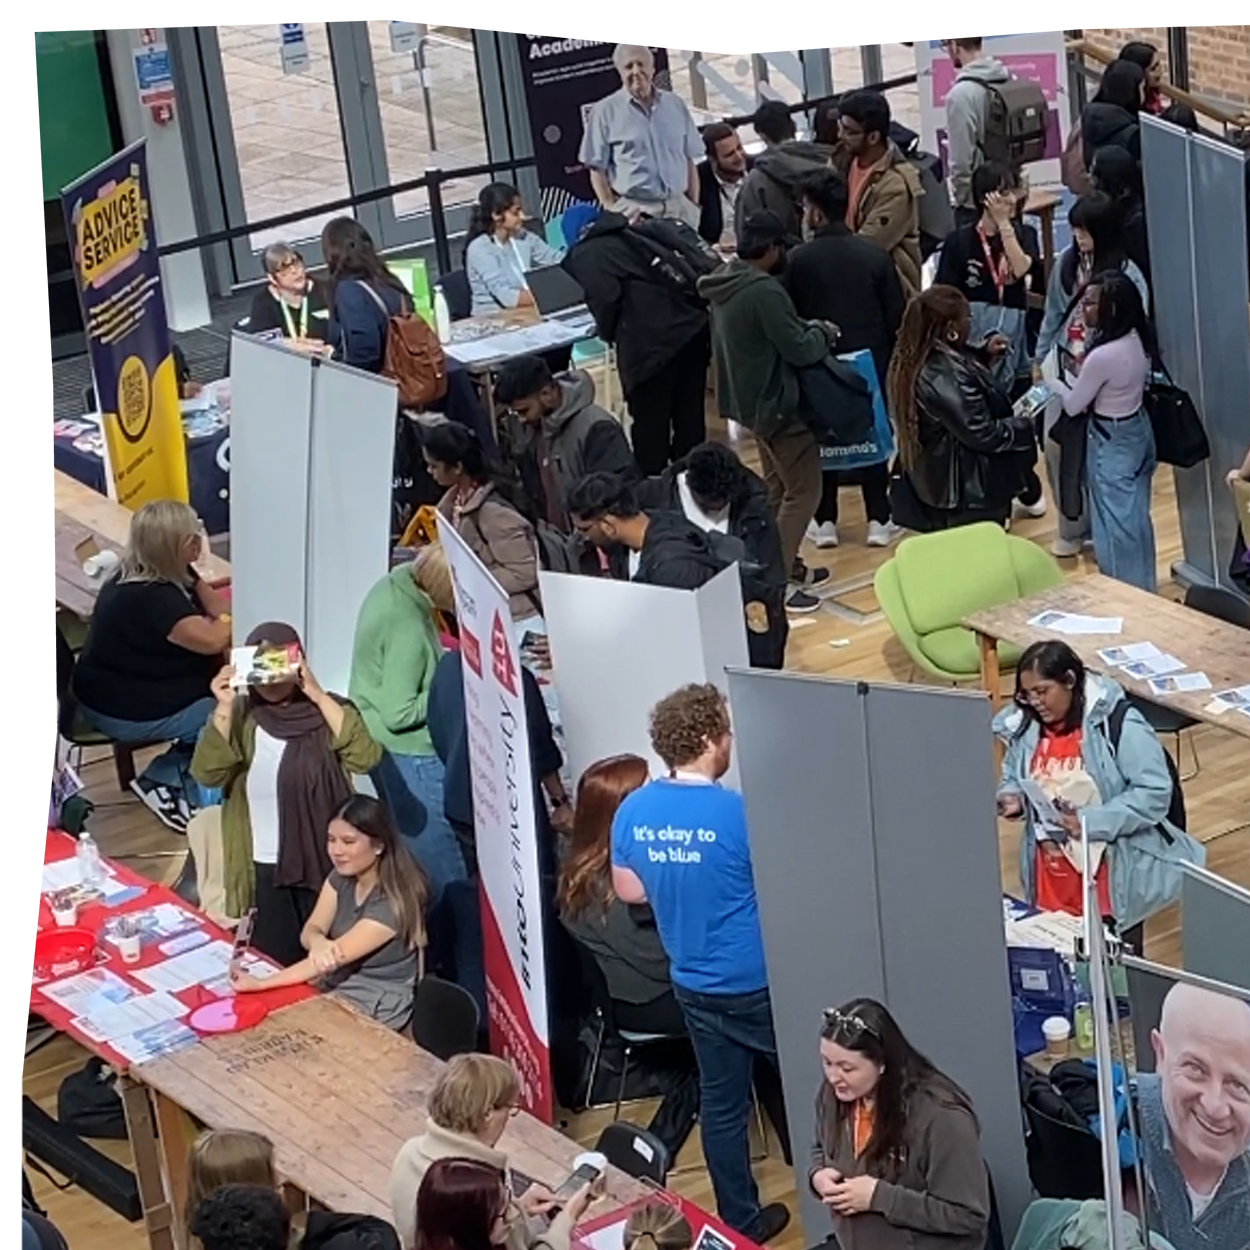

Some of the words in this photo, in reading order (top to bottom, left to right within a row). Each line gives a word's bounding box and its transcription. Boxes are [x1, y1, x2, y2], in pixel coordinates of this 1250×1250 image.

[529, 30, 612, 59] Academic
[82, 188, 138, 249] ADVICE
[84, 215, 140, 270] SERVICE
[657, 825, 693, 846] okay
[697, 827, 716, 842] to
[648, 847, 667, 862] be
[668, 847, 701, 863] blue
